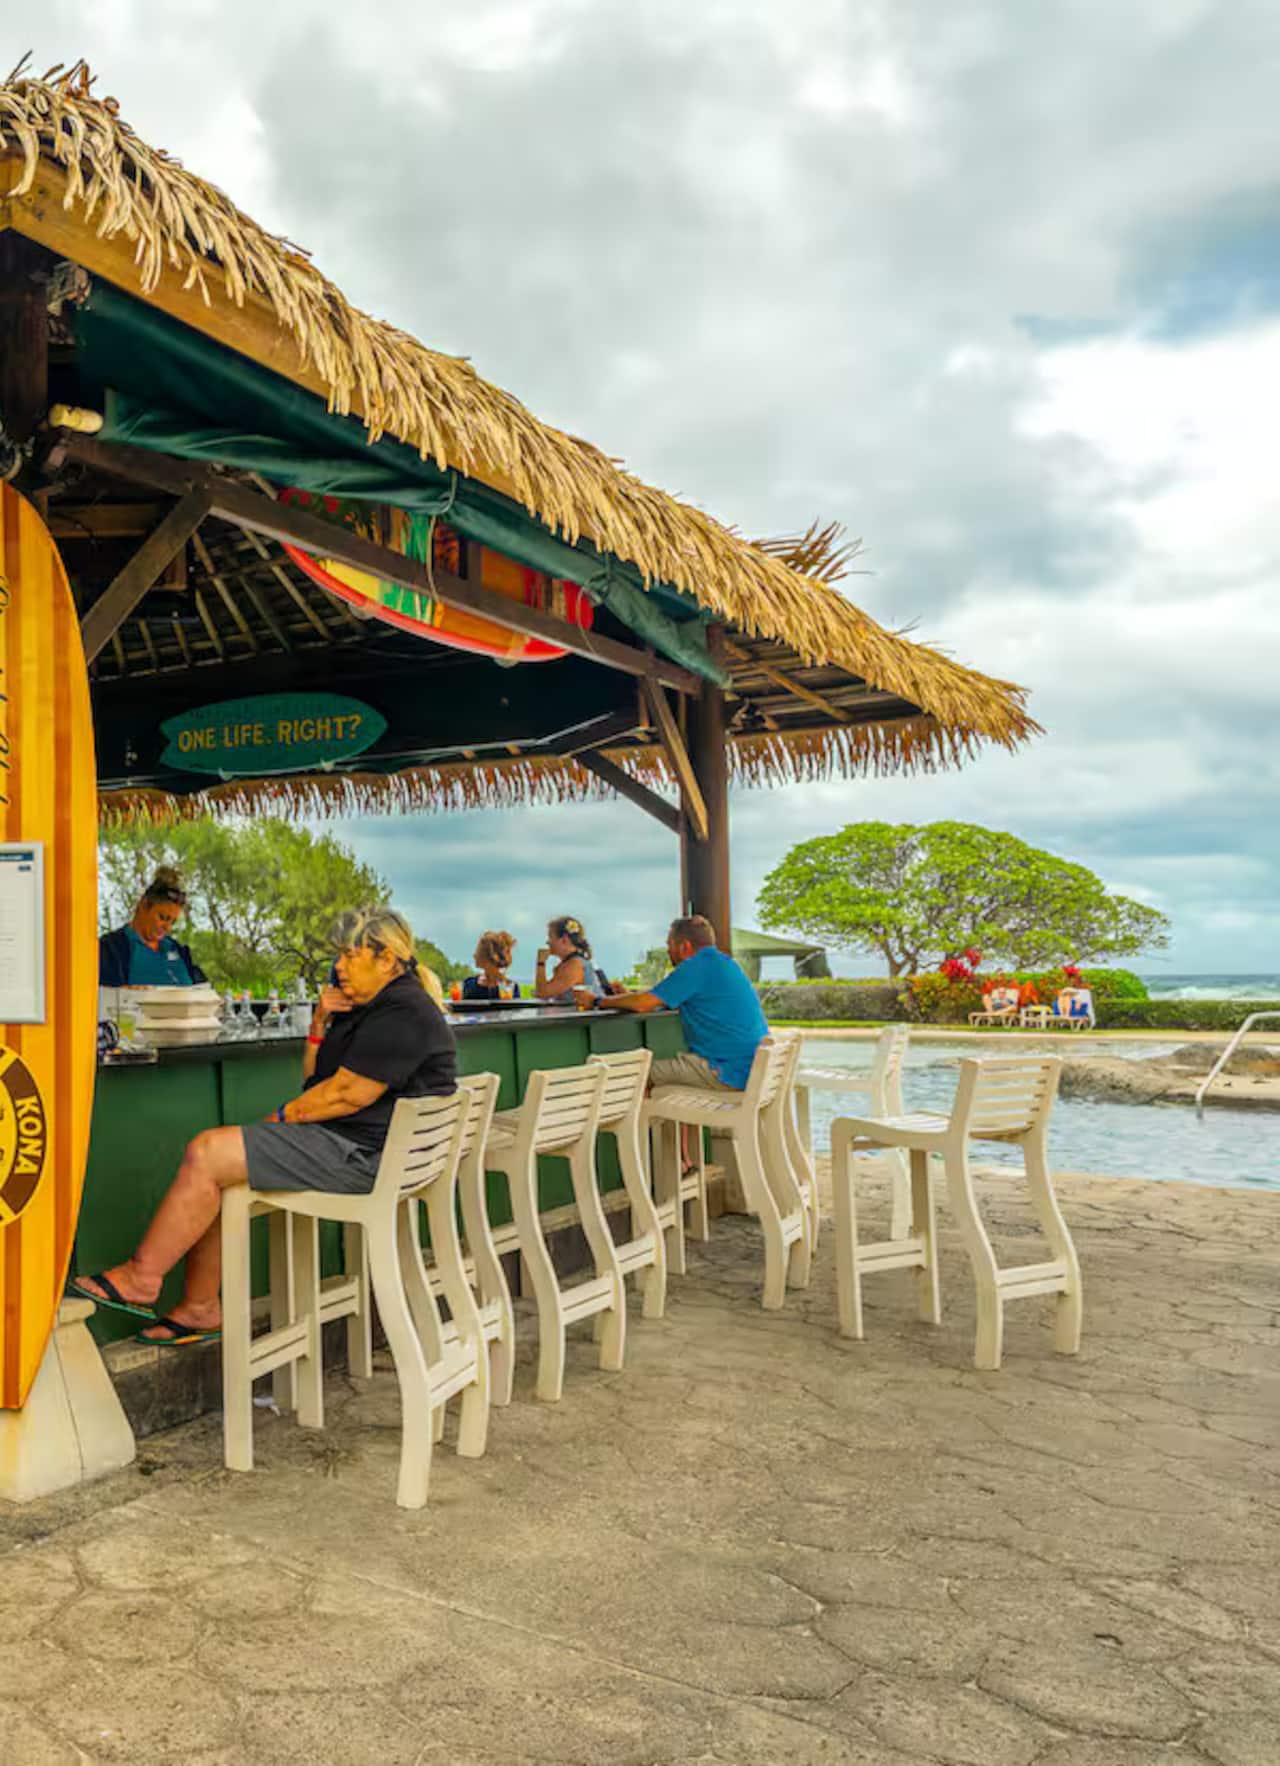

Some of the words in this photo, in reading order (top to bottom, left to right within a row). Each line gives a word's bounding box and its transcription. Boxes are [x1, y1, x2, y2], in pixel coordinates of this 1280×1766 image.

[178, 727, 217, 752] ONE
[224, 723, 272, 748] LIFE.
[277, 713, 362, 745] RIGHT?
[14, 1096, 43, 1174] KONA
